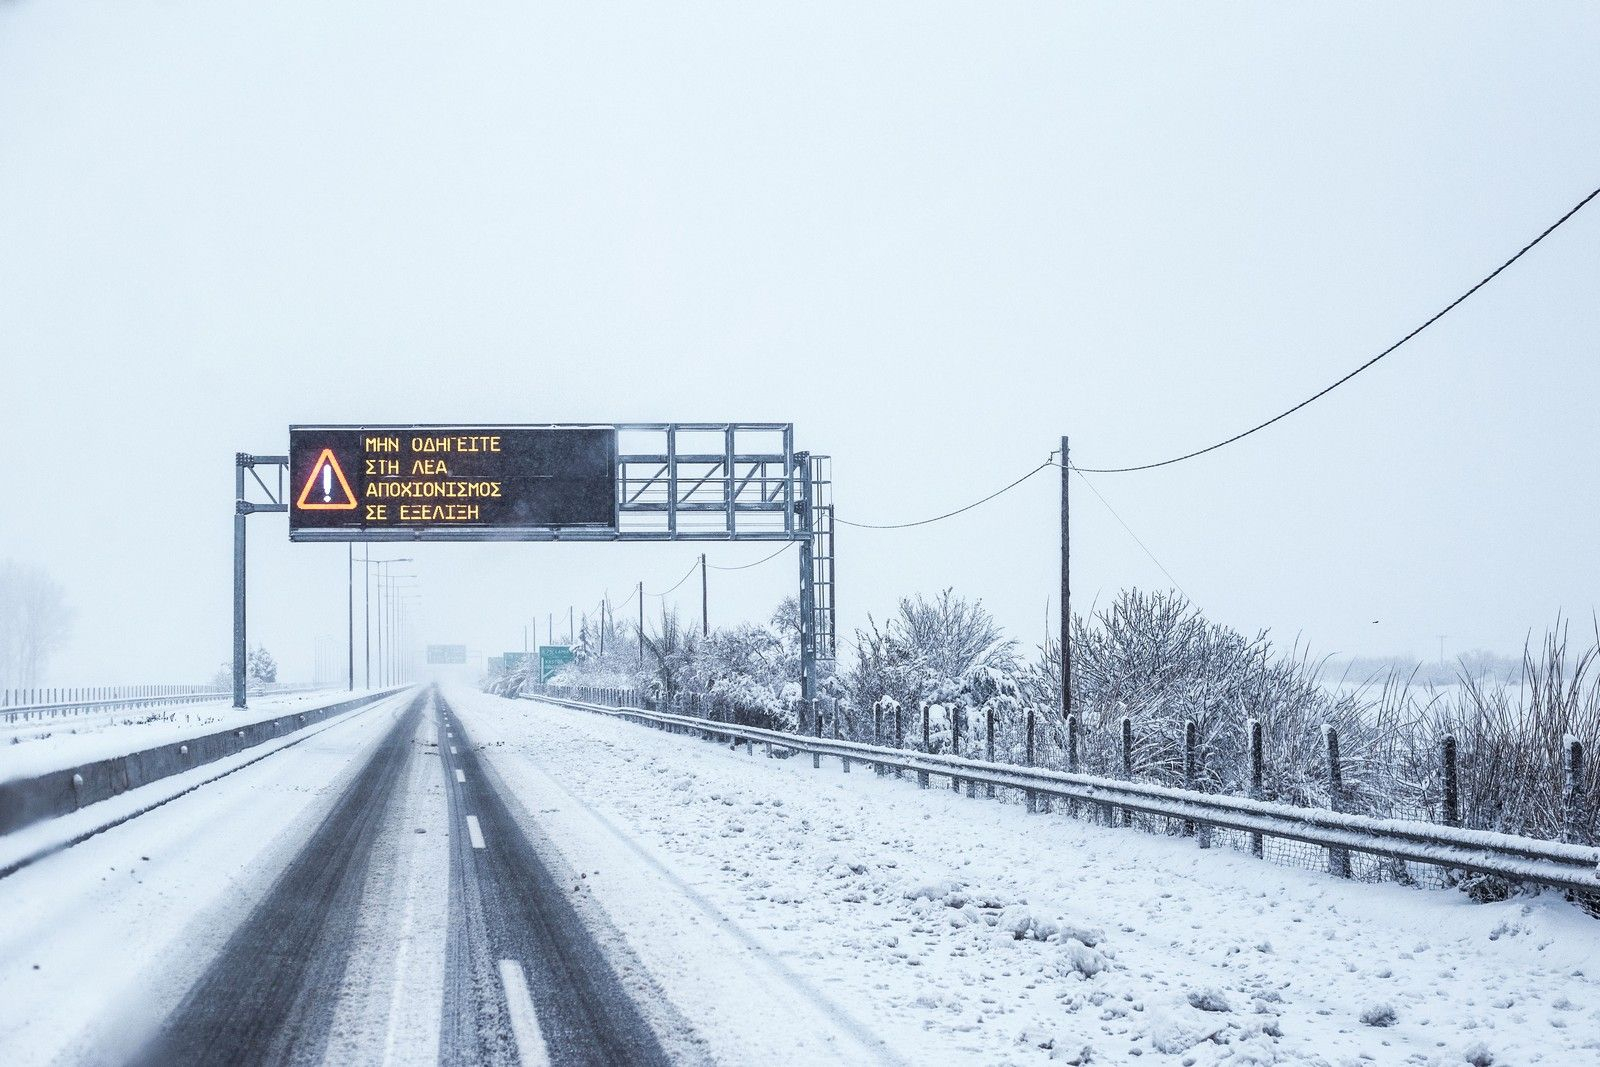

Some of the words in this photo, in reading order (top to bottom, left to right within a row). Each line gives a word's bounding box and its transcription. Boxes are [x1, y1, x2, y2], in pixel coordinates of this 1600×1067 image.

[366, 437, 399, 452] ΜΗΝ
[412, 437, 501, 452] ΟΔΗΓΕΙΤΕ
[366, 460, 399, 475] ΣΤΗ
[412, 460, 447, 475] ΛΕΑ
[366, 482, 501, 497] ΑΠΟΧΙΟΝΙΣΜΟΣ
[366, 505, 387, 520] ΣΕ
[400, 505, 479, 520] ΕΞΕΛΙΞΗ
